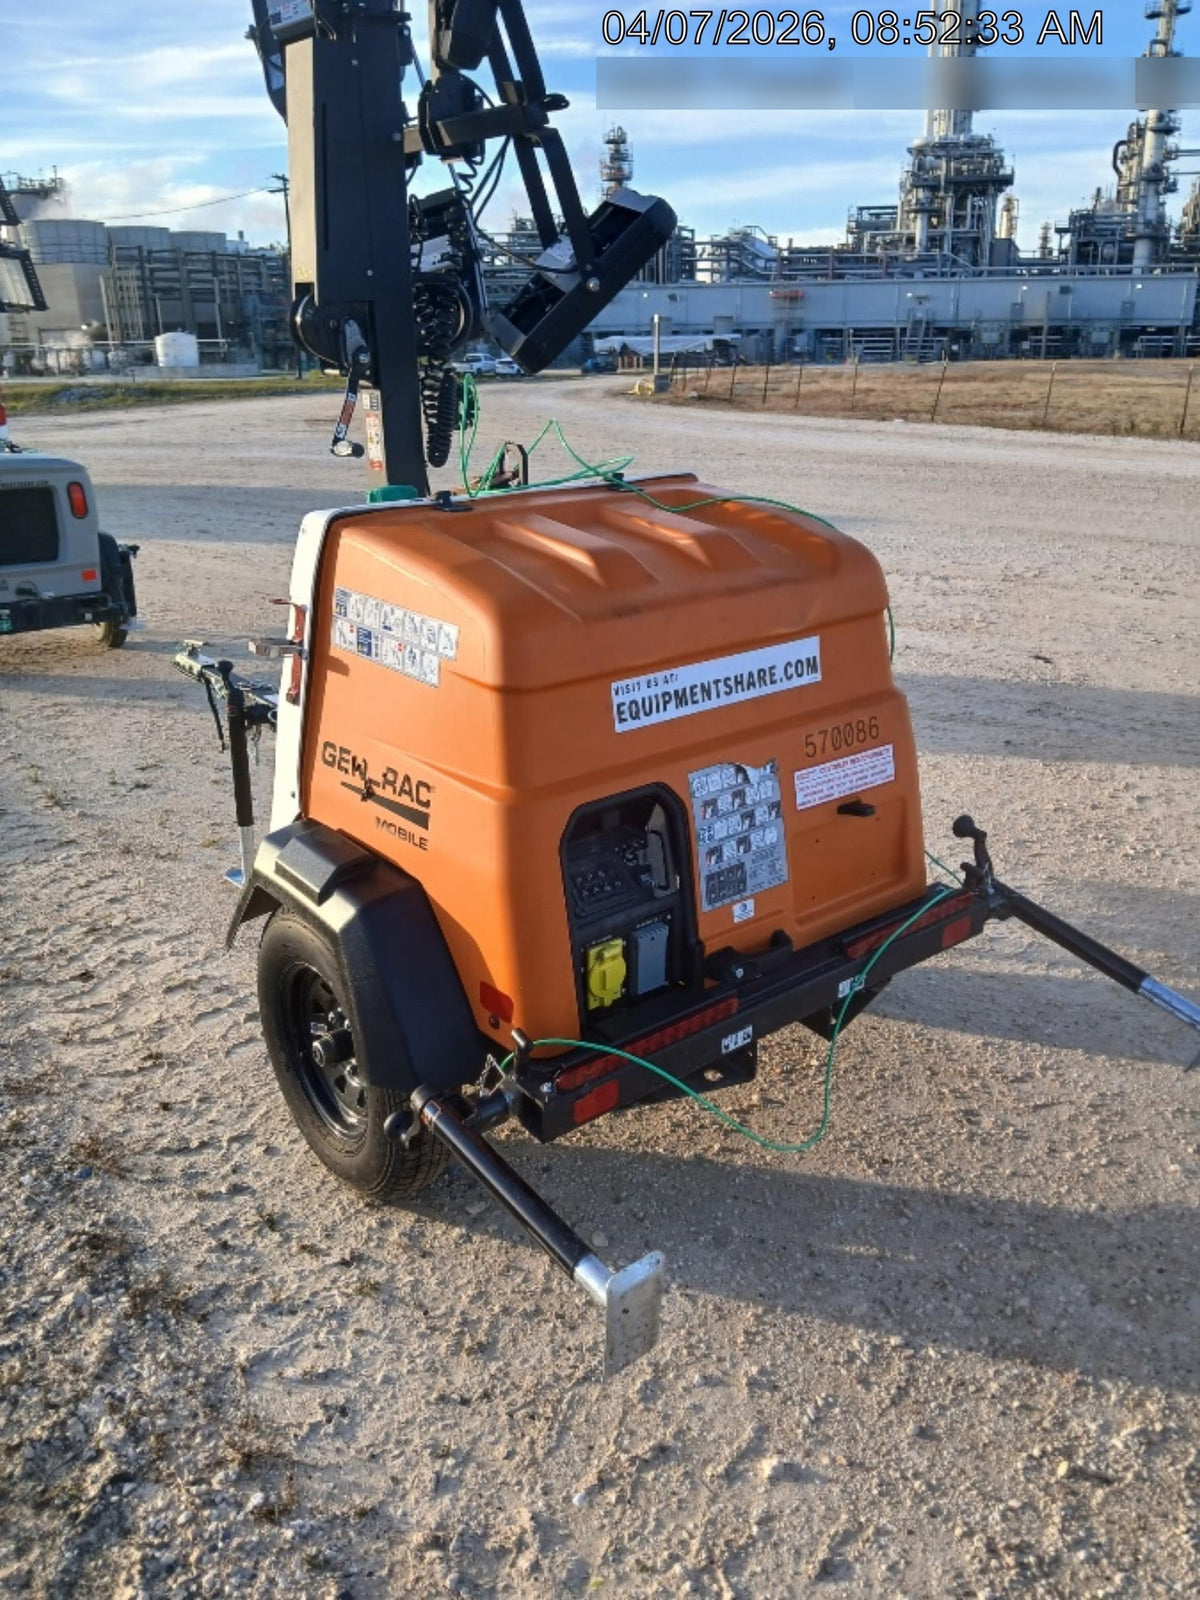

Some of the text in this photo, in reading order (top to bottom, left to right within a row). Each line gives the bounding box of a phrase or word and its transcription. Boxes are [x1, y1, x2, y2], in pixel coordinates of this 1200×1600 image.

[613, 681, 641, 696] VISIT
[616, 655, 819, 724] EQUIPMENTSHARE.COM
[804, 715, 879, 758] 570086
[375, 815, 429, 852] MOBILE
